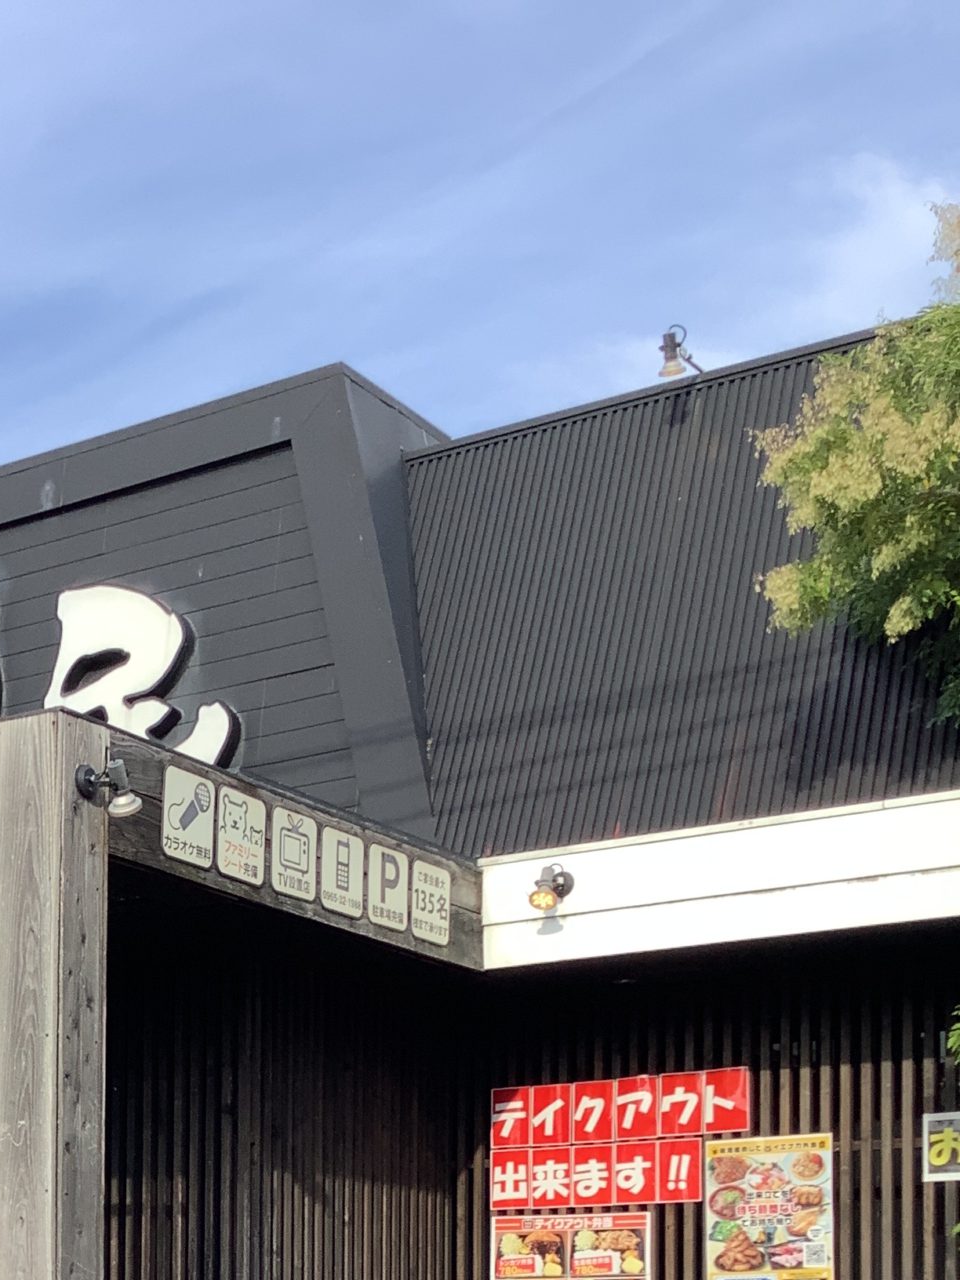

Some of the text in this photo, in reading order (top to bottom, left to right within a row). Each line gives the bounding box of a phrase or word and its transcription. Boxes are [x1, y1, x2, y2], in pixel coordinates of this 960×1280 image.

[163, 833, 211, 863] カラオケ無料
[223, 839, 259, 860] ファミリー
[222, 857, 259, 880] シート完備
[277, 872, 311, 895] TV設置店
[414, 887, 449, 921] 135名
[492, 1084, 736, 1138] テイクアウト
